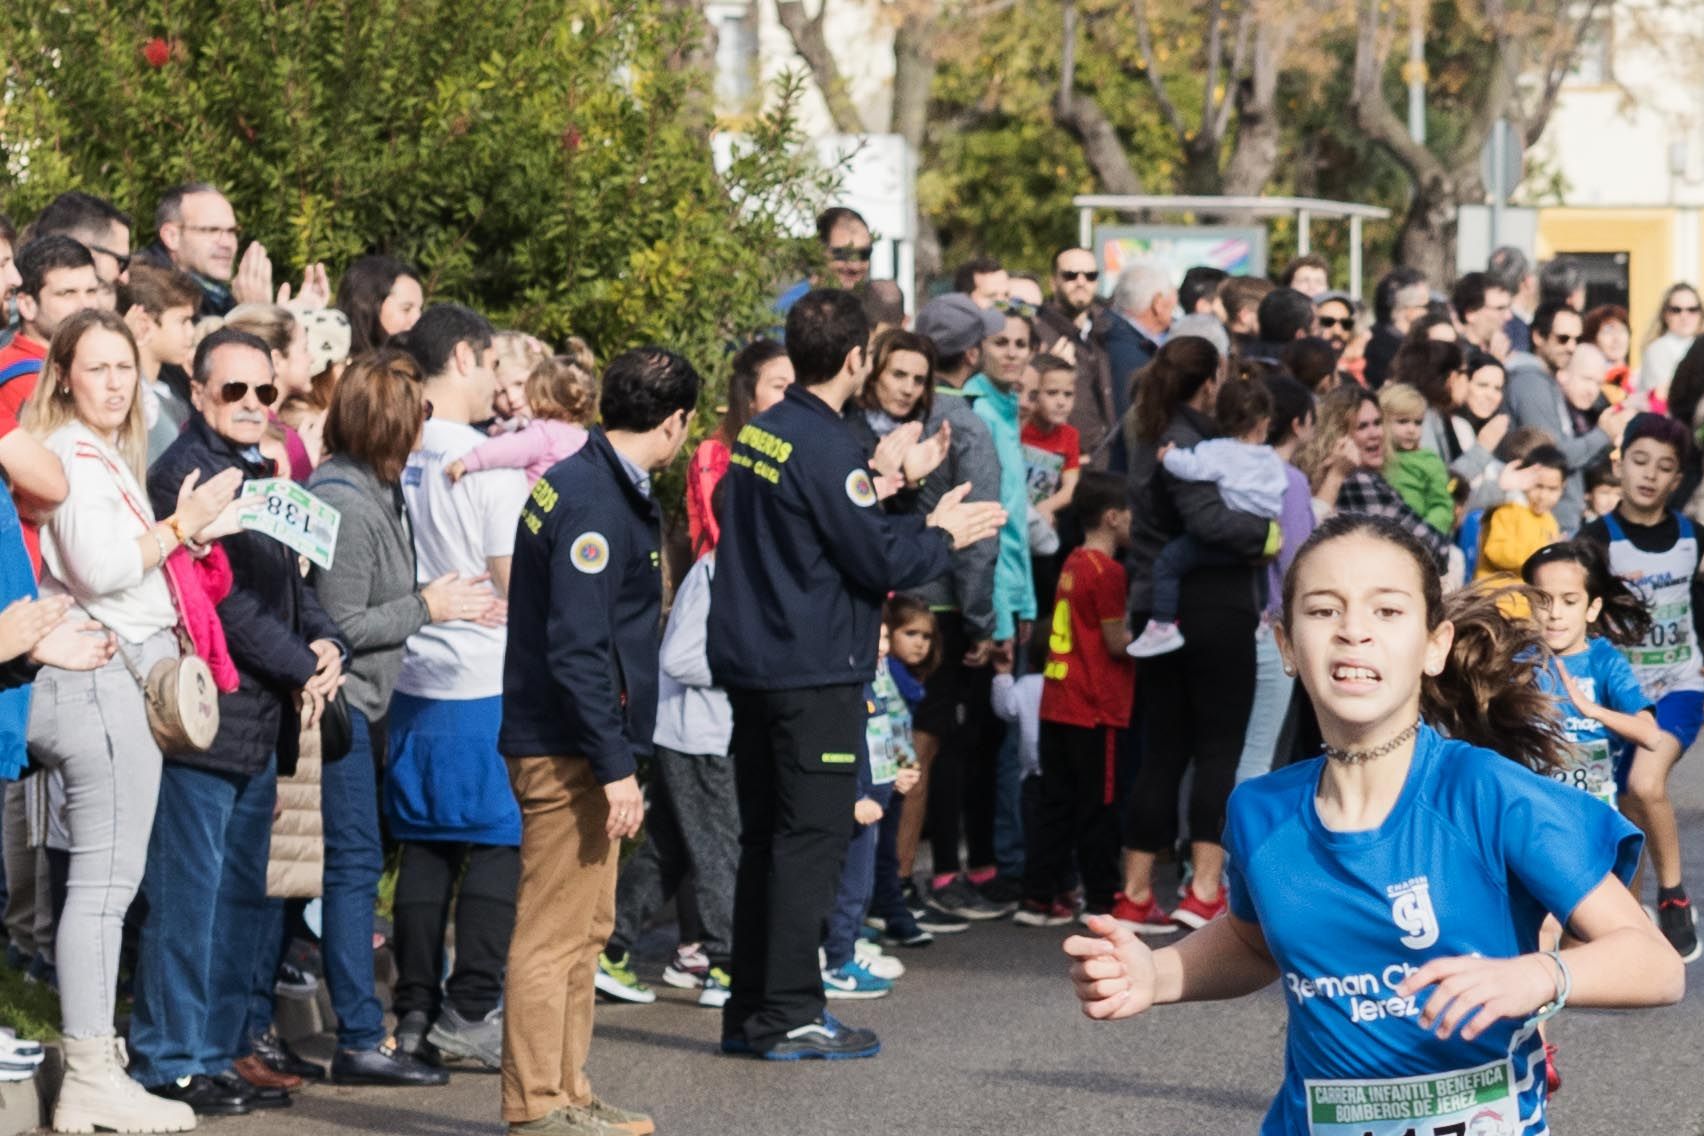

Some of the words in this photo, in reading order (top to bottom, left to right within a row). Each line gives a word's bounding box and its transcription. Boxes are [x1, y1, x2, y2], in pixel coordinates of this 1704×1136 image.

[266, 496, 311, 533] 138
[1351, 994, 1419, 1023] Jerez
[1315, 1085, 1366, 1105] CARRERA
[1368, 1081, 1433, 1102] INFANTIL
[1436, 1066, 1504, 1097] BENEFICA
[1336, 1101, 1411, 1123] BOMBEROS
[1412, 1099, 1434, 1118] DE
[1436, 1089, 1478, 1115] JEREZ
